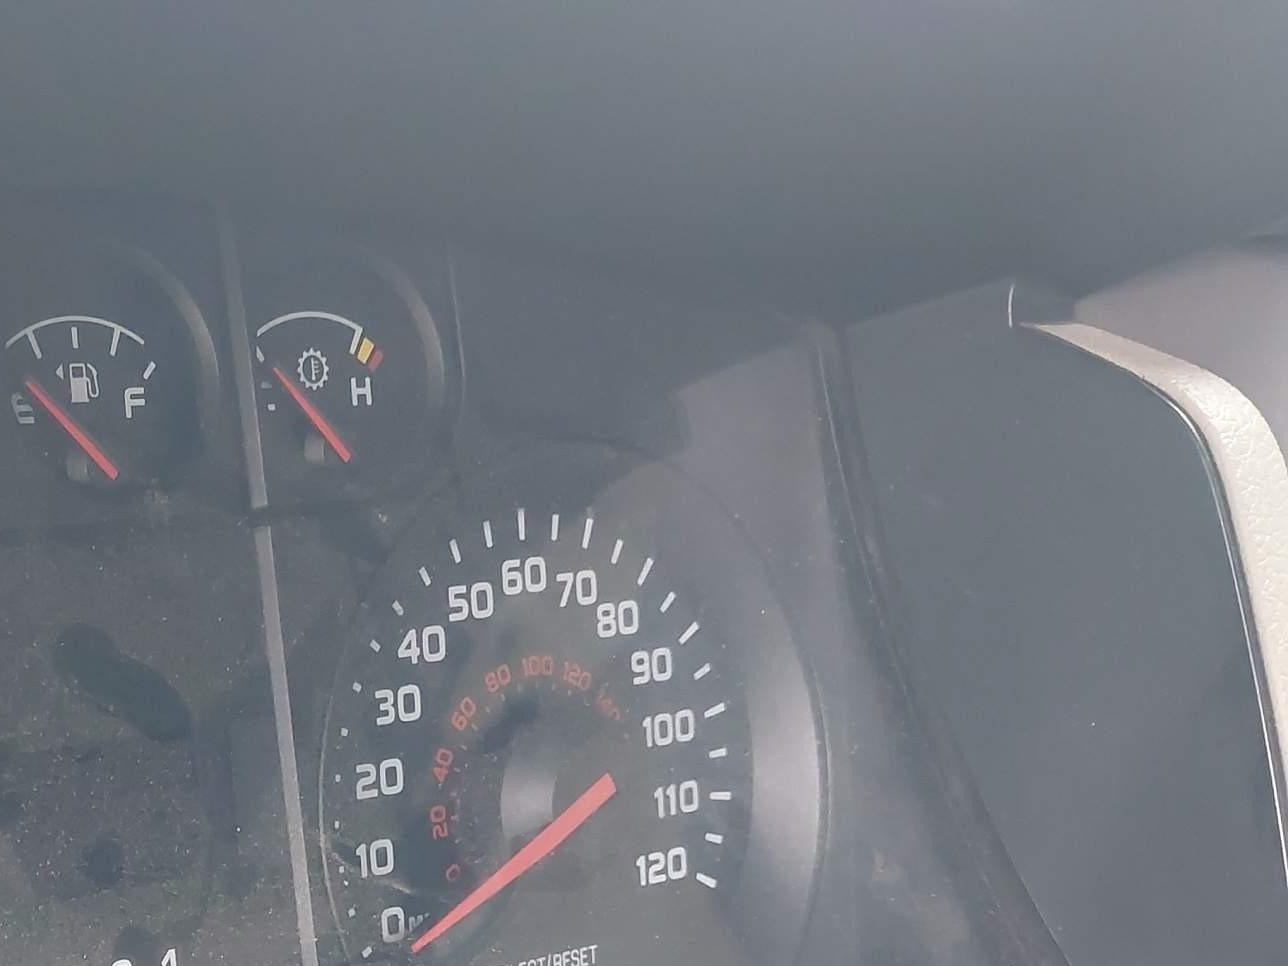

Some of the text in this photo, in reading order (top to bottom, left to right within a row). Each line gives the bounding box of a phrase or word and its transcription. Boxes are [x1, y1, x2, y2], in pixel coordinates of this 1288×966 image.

[124, 386, 146, 419] F
[350, 376, 373, 406] H
[501, 556, 547, 595] 60
[556, 569, 598, 608] 70
[448, 581, 494, 622] 50
[597, 600, 640, 638] 80
[397, 625, 446, 664] 40
[484, 664, 511, 692] 80
[522, 655, 553, 677] 100
[563, 661, 592, 690] 120
[631, 647, 672, 686] 90
[375, 685, 422, 726] 30
[451, 696, 476, 731] 60
[642, 709, 696, 748] 100
[355, 758, 404, 800] 20
[433, 747, 454, 783] 40
[654, 780, 699, 819] 110
[430, 804, 448, 840] 20
[356, 838, 395, 879] 10
[445, 863, 461, 882] 0
[636, 846, 688, 887] 120
[381, 906, 405, 943] 0
